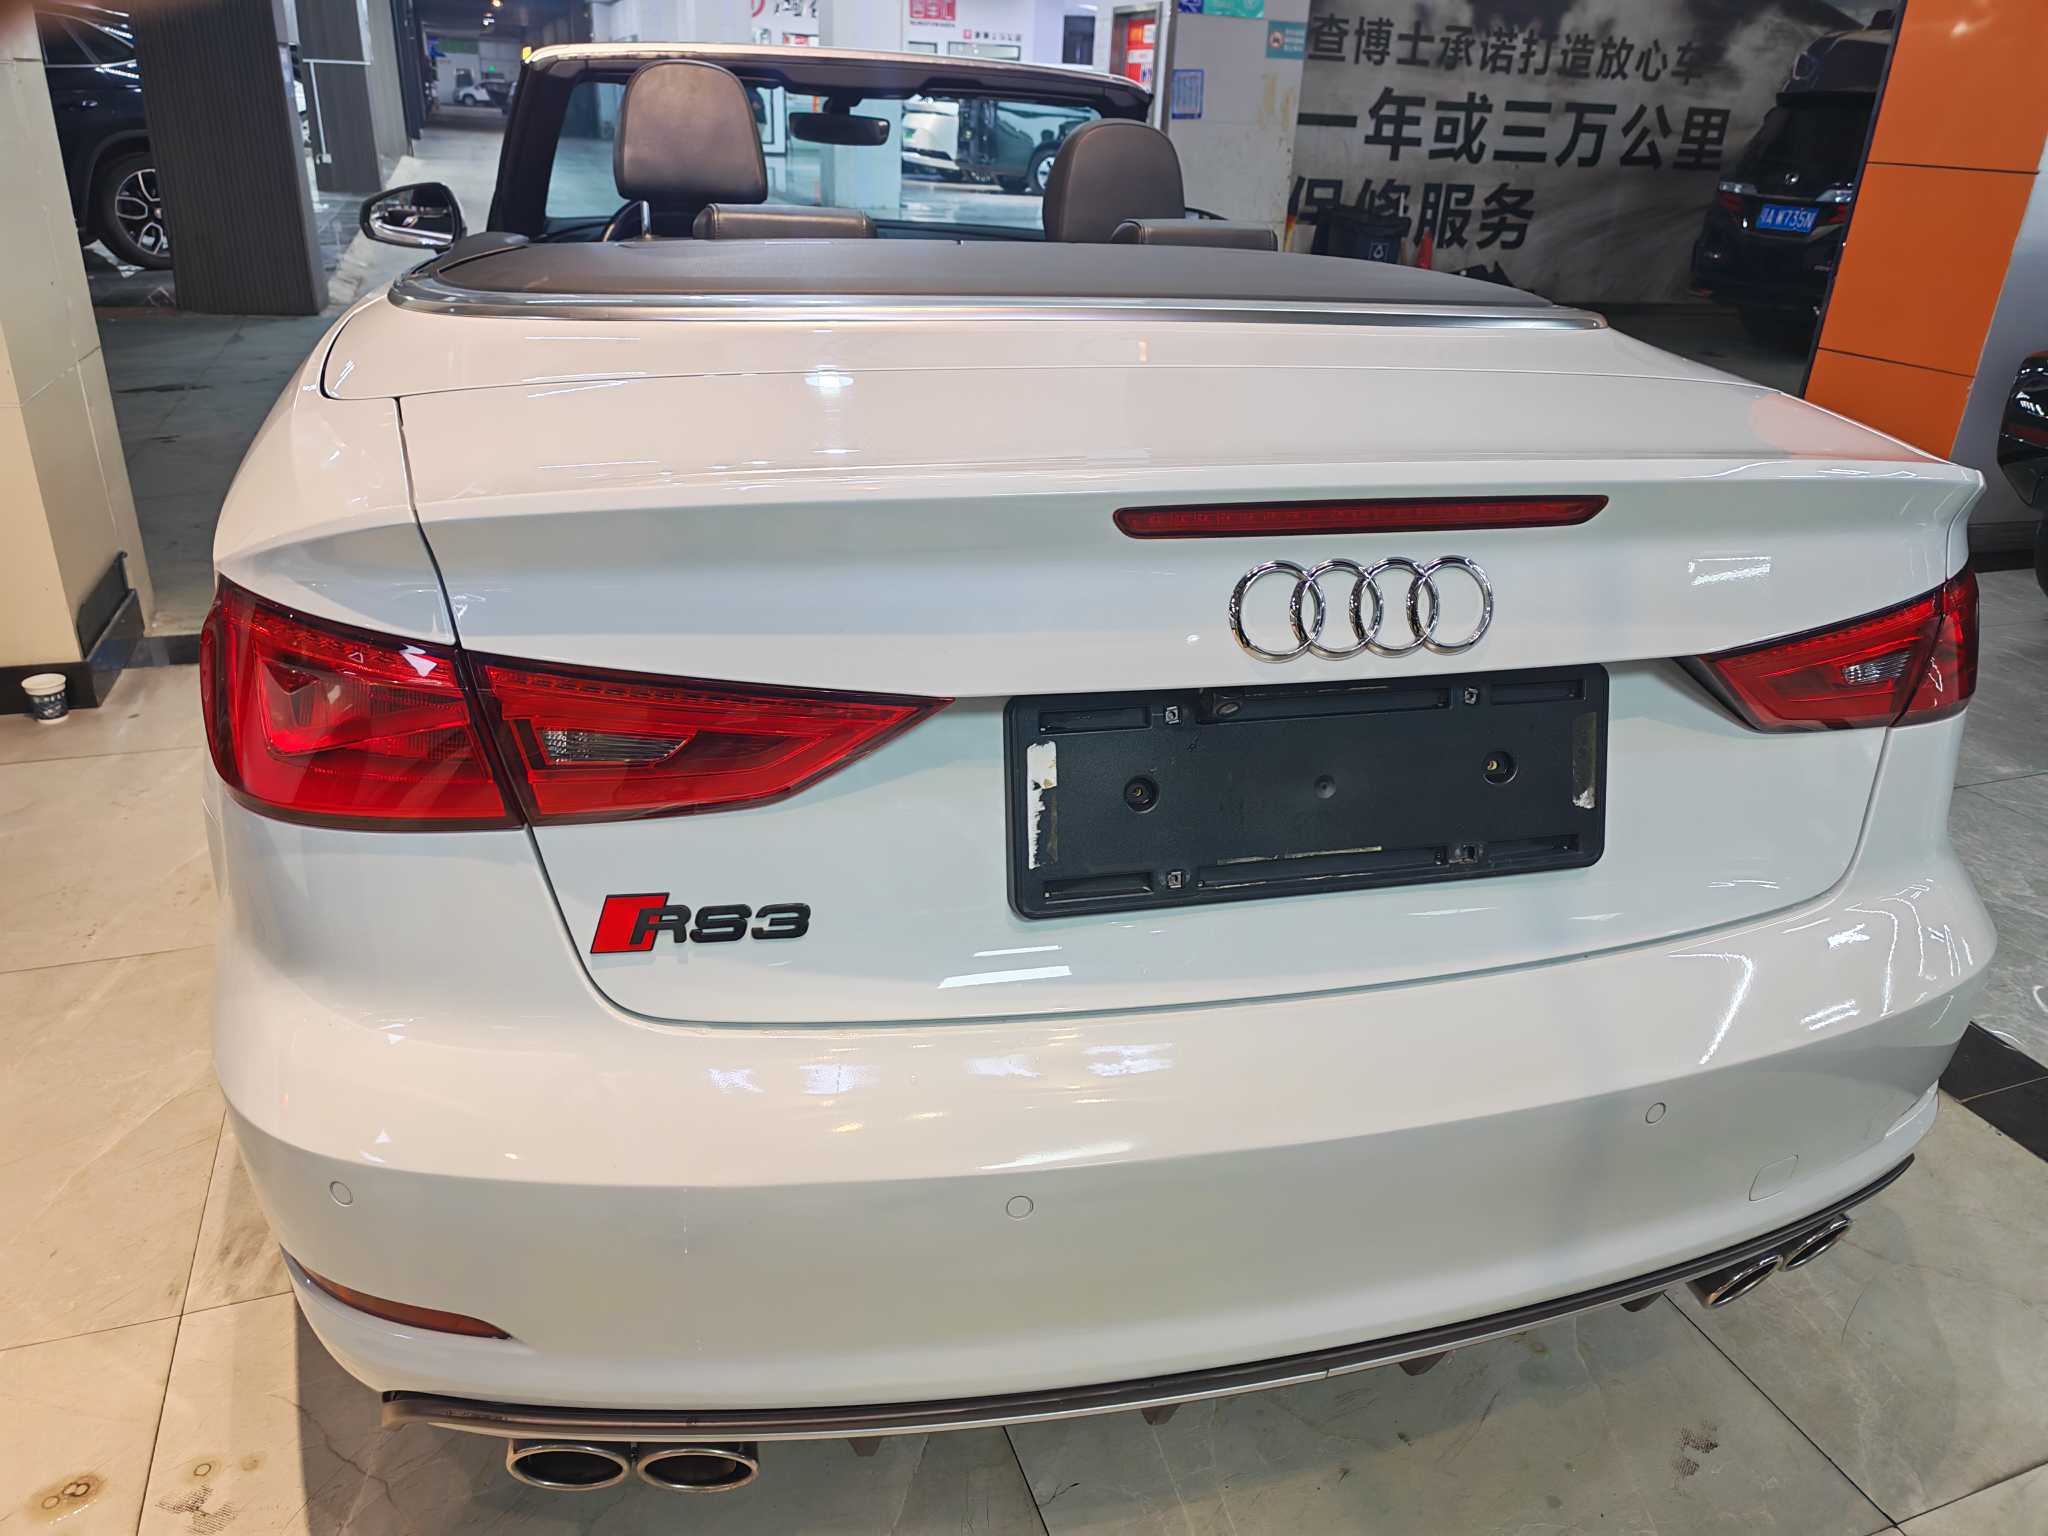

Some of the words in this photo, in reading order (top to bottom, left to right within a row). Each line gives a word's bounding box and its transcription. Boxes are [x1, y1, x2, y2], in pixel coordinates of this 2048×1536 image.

[1307, 13, 1707, 86] 查博士承诺打造放心车
[1297, 87, 1731, 171] 一年或三万公里
[629, 903, 811, 945] RS3
